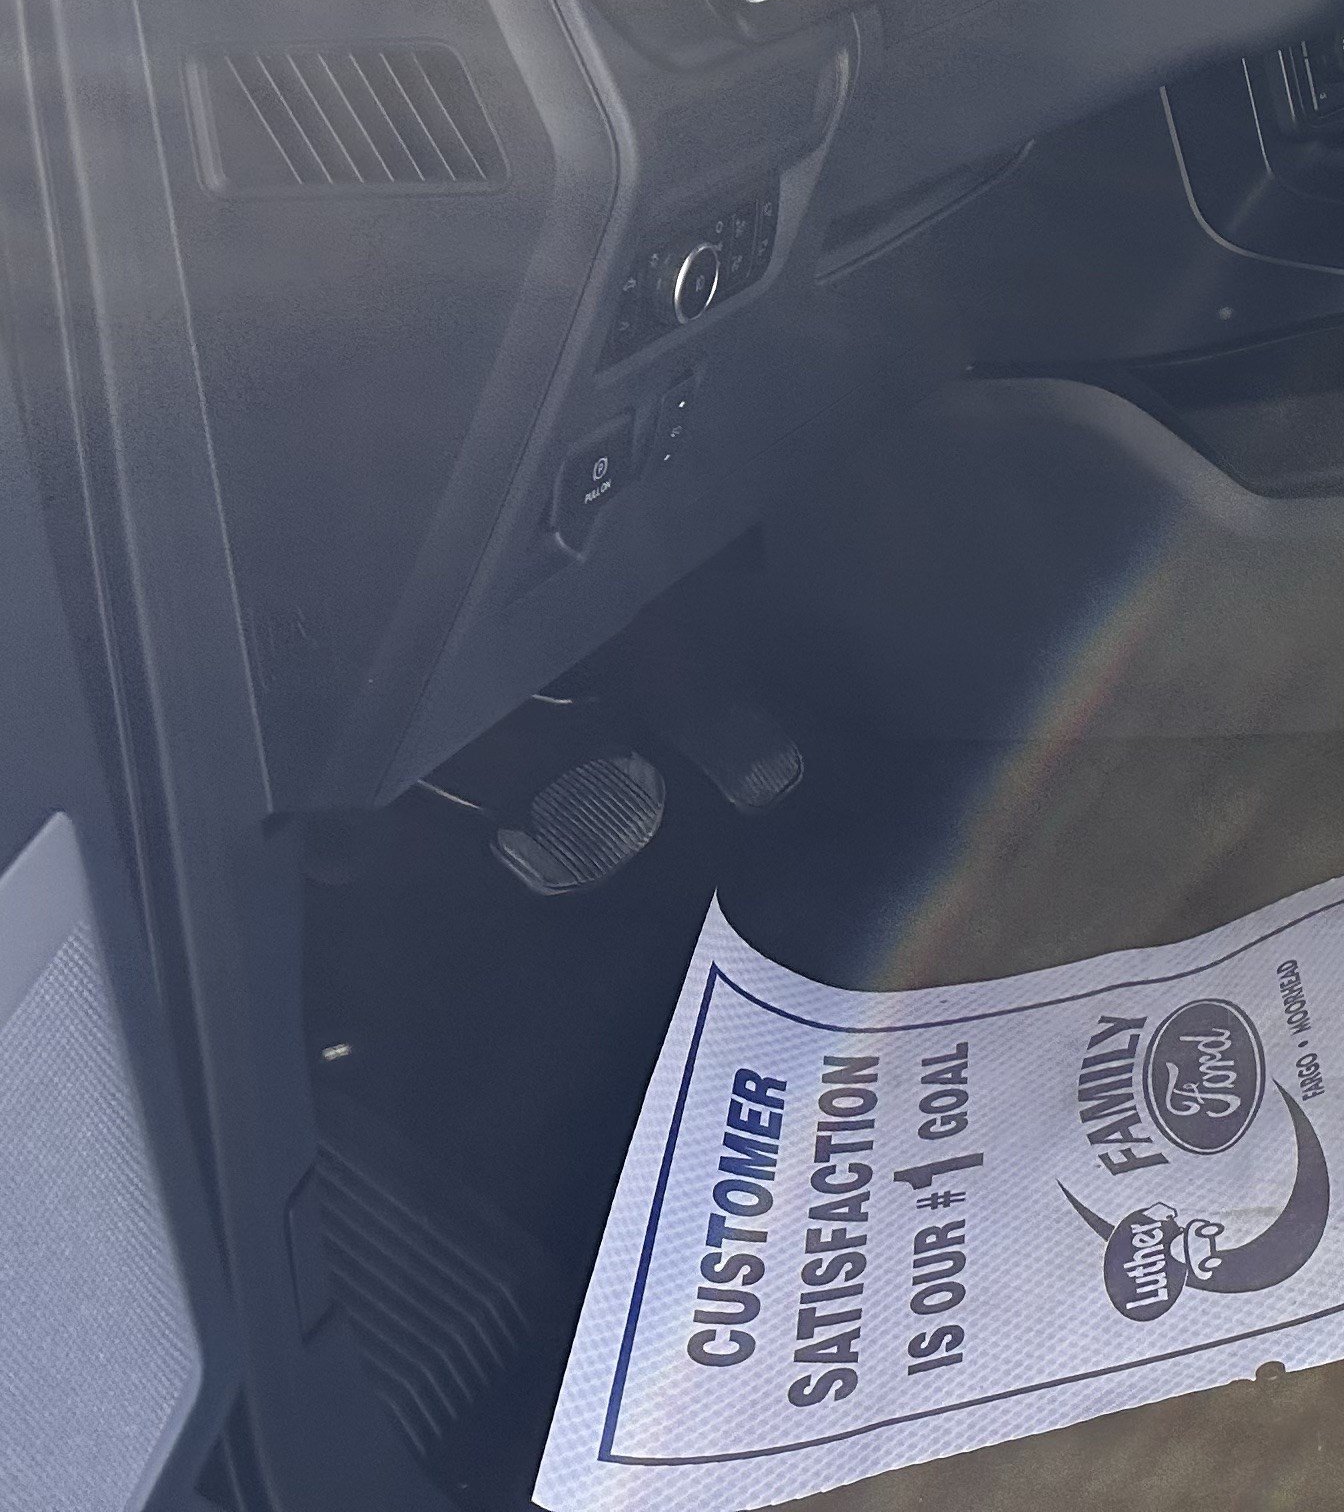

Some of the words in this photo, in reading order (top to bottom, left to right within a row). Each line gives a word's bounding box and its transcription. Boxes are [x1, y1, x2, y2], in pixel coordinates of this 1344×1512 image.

[1276, 958, 1313, 1037] MOORHEAD
[917, 1041, 970, 1140] GOAL
[1077, 1014, 1171, 1177] FAMILY
[1165, 1027, 1241, 1119] Ford
[1295, 1051, 1326, 1102] FARGO
[687, 1066, 788, 1368] CUSTOMER
[893, 1151, 985, 1211] #1
[787, 1055, 880, 1408] SATISFACTION
[909, 1218, 967, 1316] OUR
[1123, 1219, 1170, 1311] Luther
[907, 1323, 965, 1376] IS
